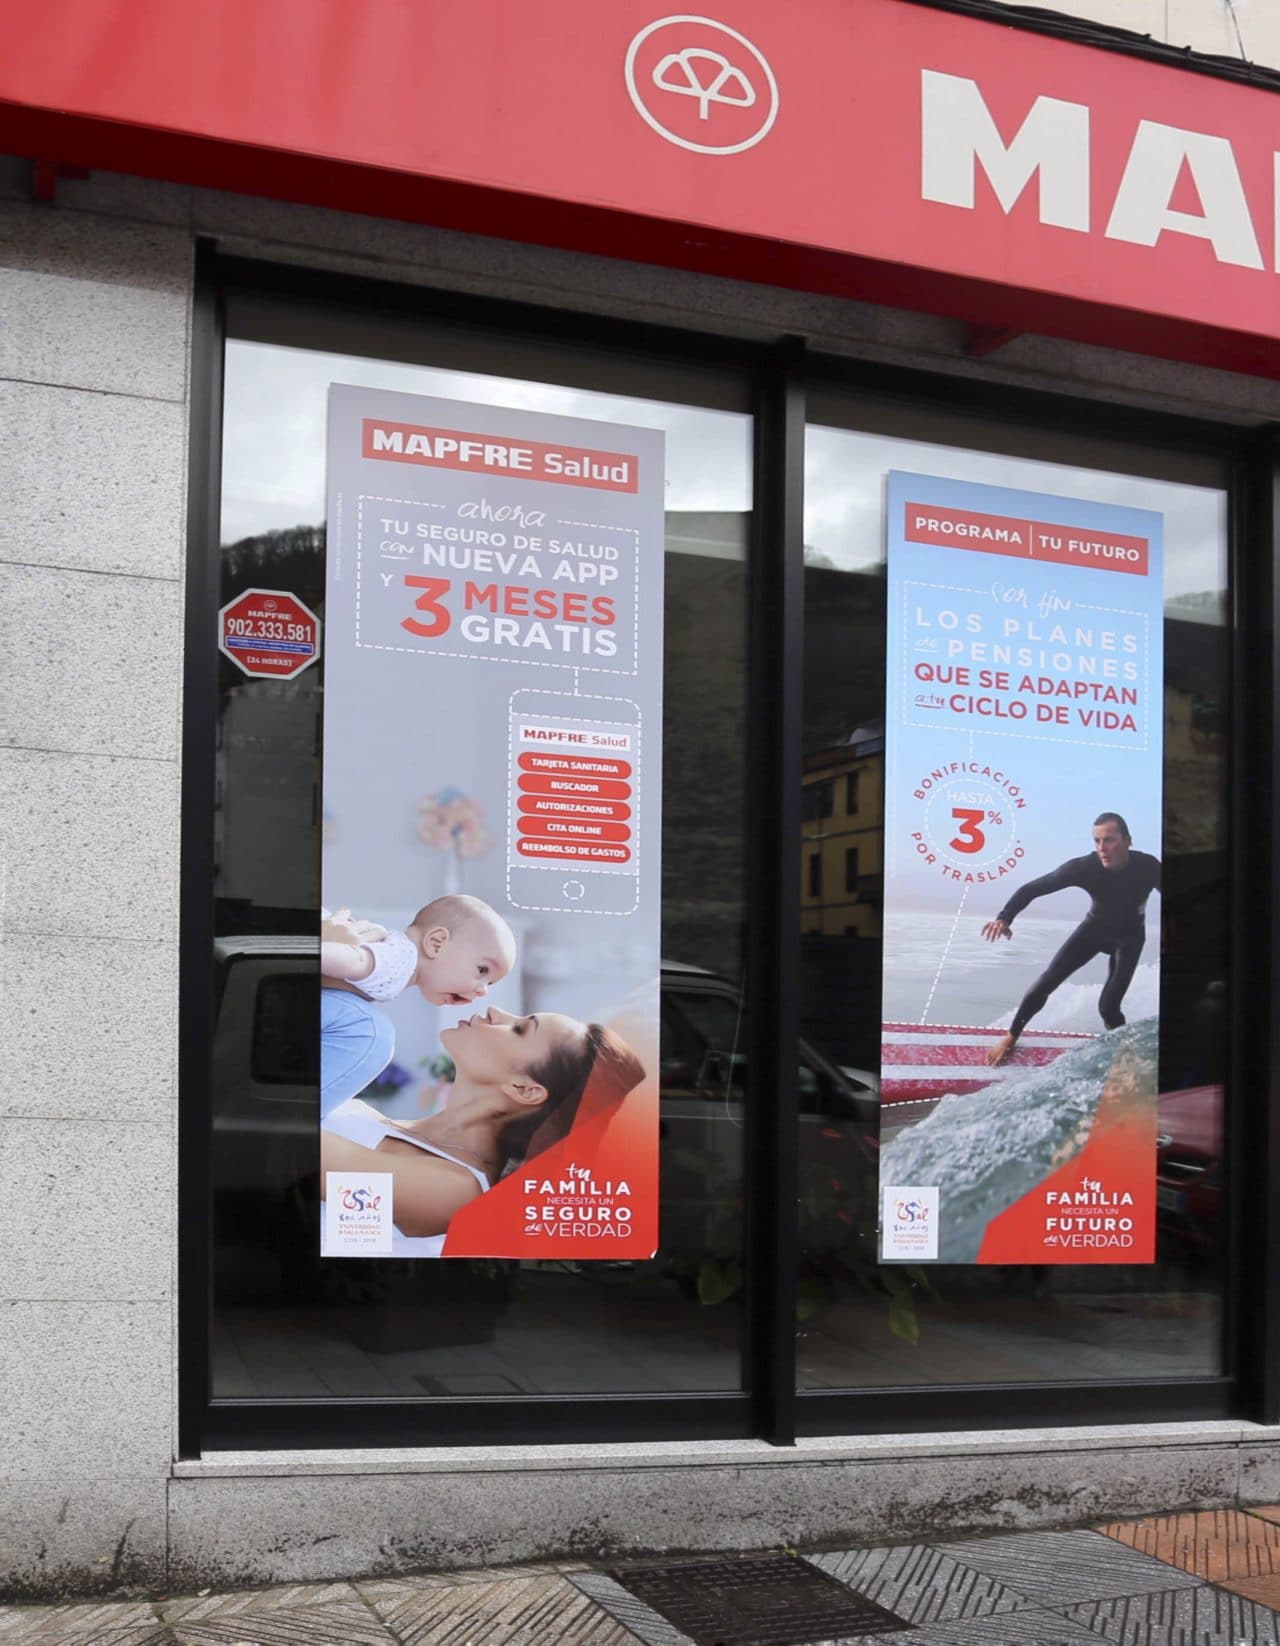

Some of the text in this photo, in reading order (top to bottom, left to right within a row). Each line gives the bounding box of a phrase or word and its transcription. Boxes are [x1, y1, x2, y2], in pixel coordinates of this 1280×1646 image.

[373, 429, 629, 484] MAPFRE Salud
[457, 498, 547, 528] ahora
[380, 518, 619, 561] TU SEGURO DE SALUD
[916, 517, 1140, 562] PROGRAMA TU FUTURO
[379, 540, 619, 586] con NUEVA APP
[380, 572, 616, 638] Y 3 MESES
[247, 610, 293, 620] MAPFRE
[227, 618, 312, 642] 902.333.581
[460, 614, 617, 657] GRATIS
[916, 607, 1138, 651] LOS PLANES
[948, 639, 1138, 681] PENSIONES
[914, 662, 1138, 705] QUE SE ADAPTAN
[949, 694, 1027, 720] CICLO
[1036, 704, 1069, 725] DE
[1077, 708, 1138, 732] VIDA
[523, 729, 627, 748] MAPFRE Salud
[531, 757, 619, 774] TARJETA SANITARIA
[551, 780, 599, 793] BUSCADOR
[913, 761, 1027, 809] BONIFICACIÓN
[947, 791, 994, 805] HASTA
[535, 800, 614, 815] AUTORIZACIONES
[546, 822, 602, 836] CITA ONLINE
[521, 842, 626, 858] REEMBOLSO DE GASTOS
[911, 832, 937, 865] POR
[565, 1163, 592, 1181] tu
[524, 1180, 632, 1195] FAMILIA
[1080, 1177, 1101, 1193] tu
[546, 1197, 596, 1205] NECESITA
[1046, 1192, 1134, 1205] FAMILIA
[525, 1206, 632, 1221] SEGURO
[1061, 1207, 1103, 1215] NECESITA
[543, 1222, 632, 1238] VERDAD
[1046, 1218, 1133, 1231] FUTURO
[1059, 1234, 1134, 1248] VERDAD
